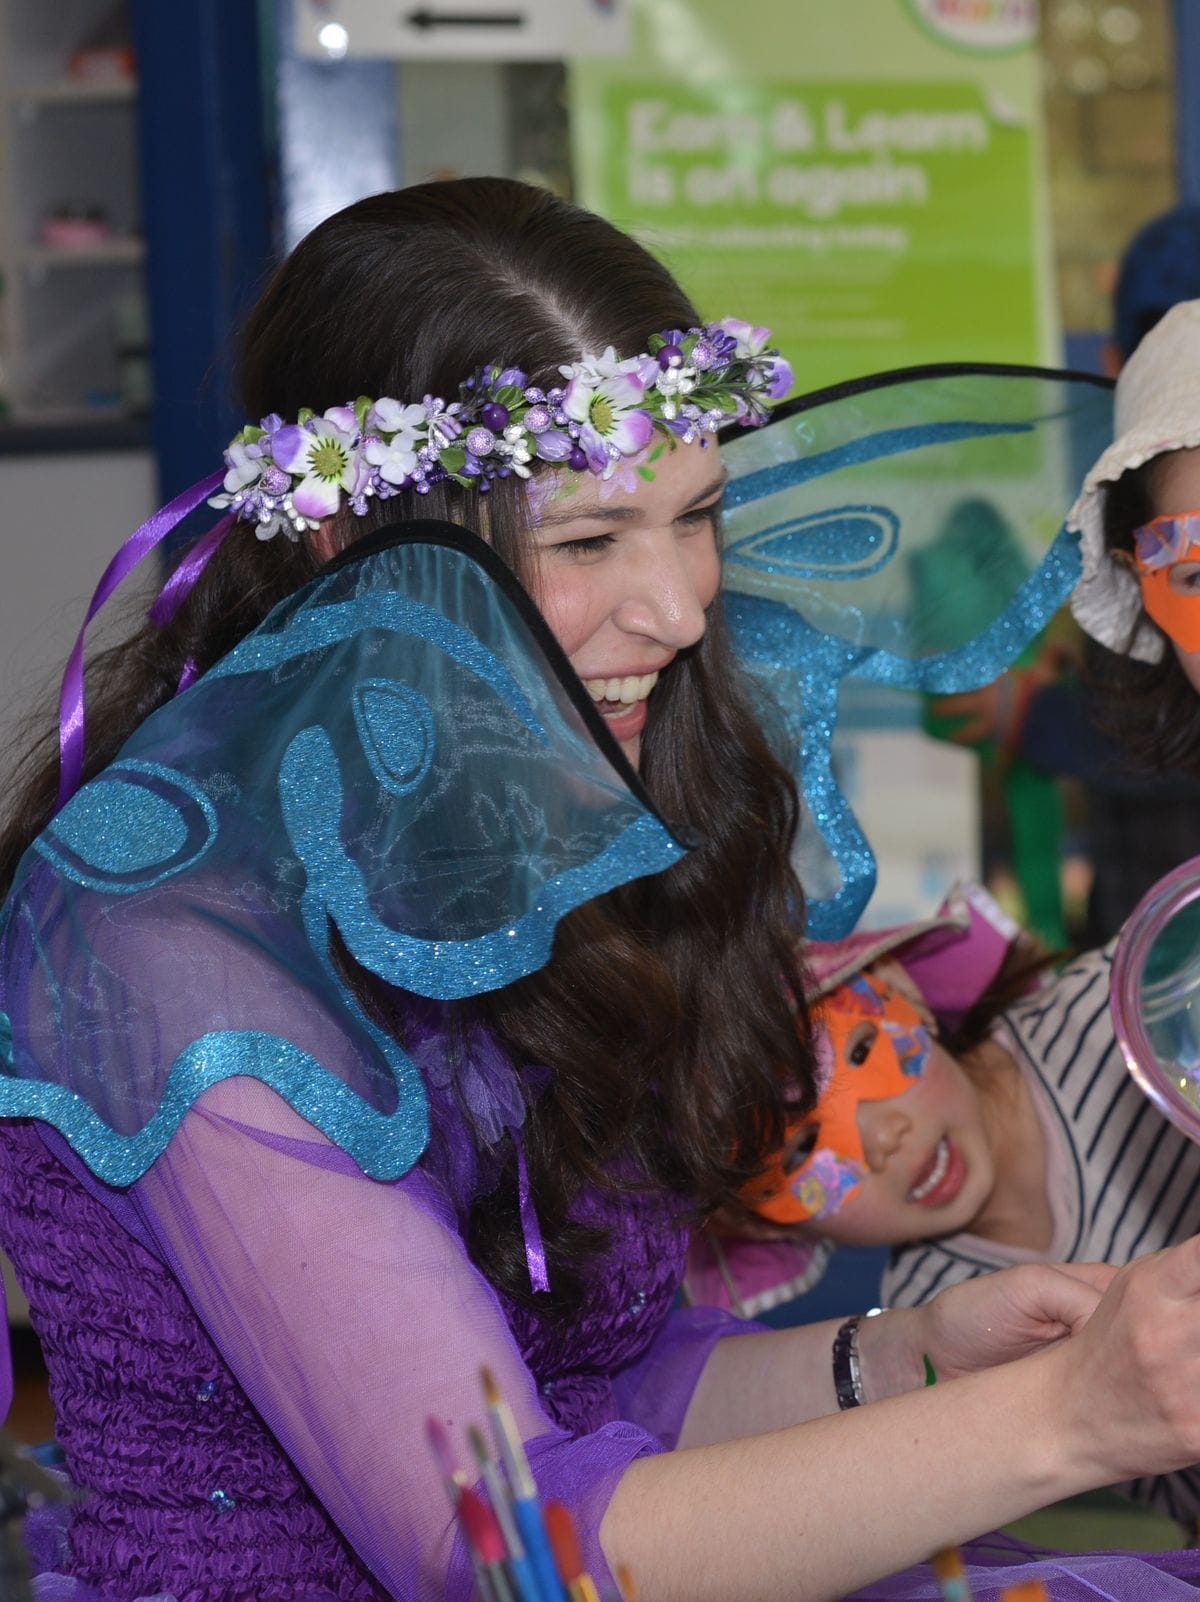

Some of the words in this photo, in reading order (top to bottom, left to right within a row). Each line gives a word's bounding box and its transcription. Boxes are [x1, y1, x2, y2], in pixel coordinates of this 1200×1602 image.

[628, 101, 760, 151] Earn
[773, 101, 813, 151] &
[825, 101, 989, 151] Learn
[629, 155, 672, 203] is
[685, 164, 758, 203] on
[767, 155, 930, 218] again
